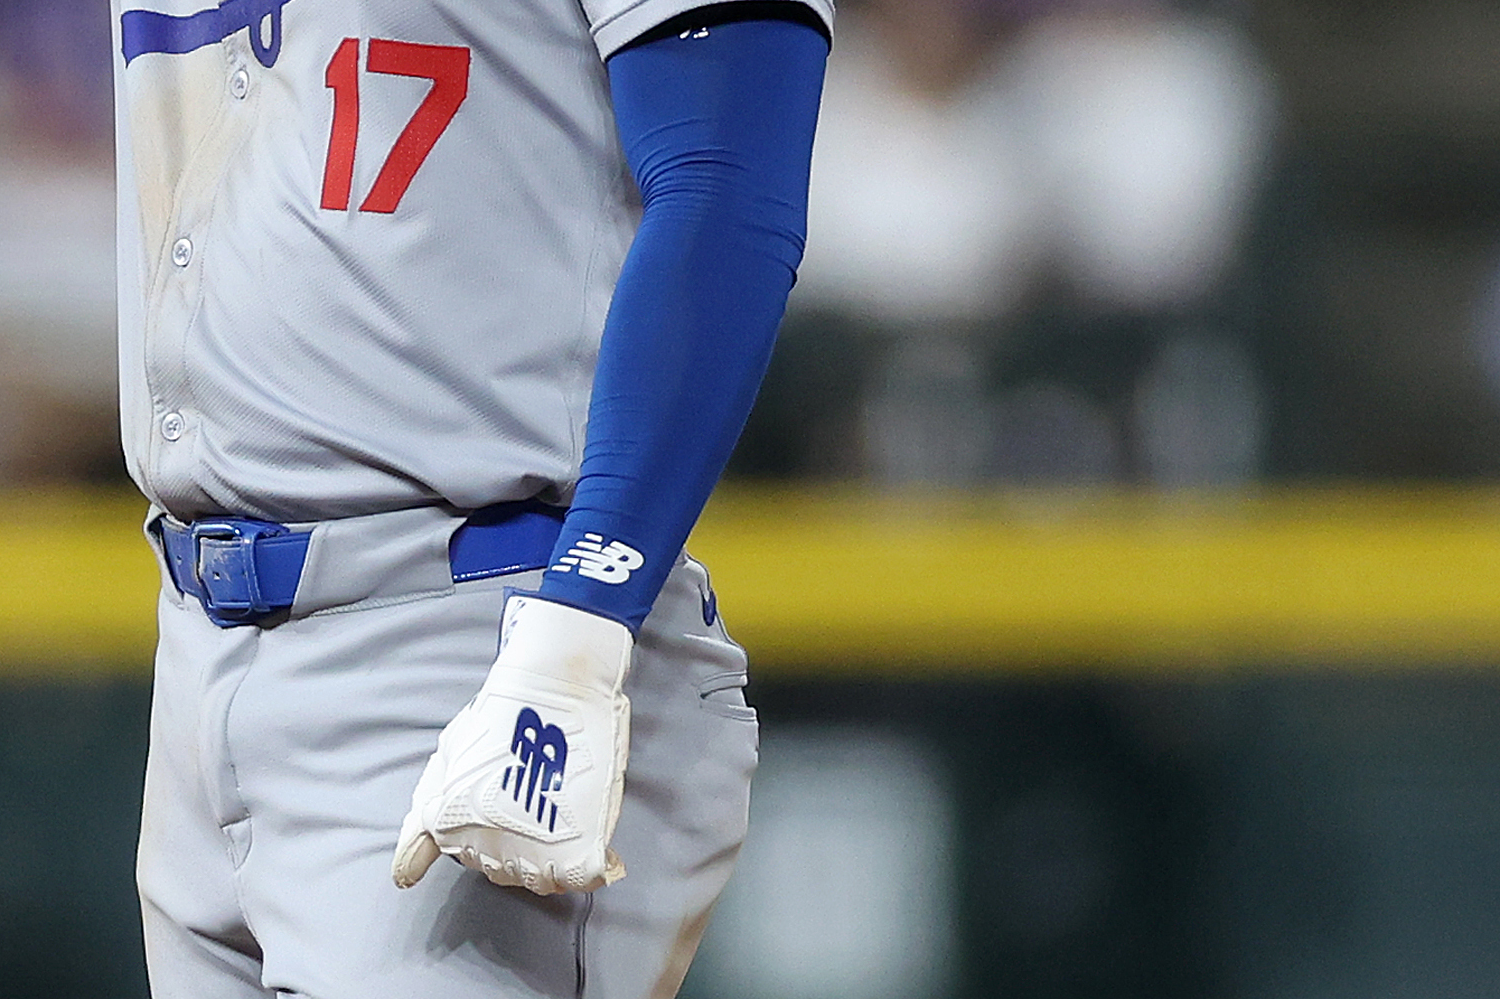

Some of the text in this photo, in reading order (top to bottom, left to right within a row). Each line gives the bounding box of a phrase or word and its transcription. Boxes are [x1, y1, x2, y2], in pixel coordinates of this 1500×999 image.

[320, 37, 471, 214] 17
[551, 531, 645, 584] NB
[502, 706, 569, 834] NB
